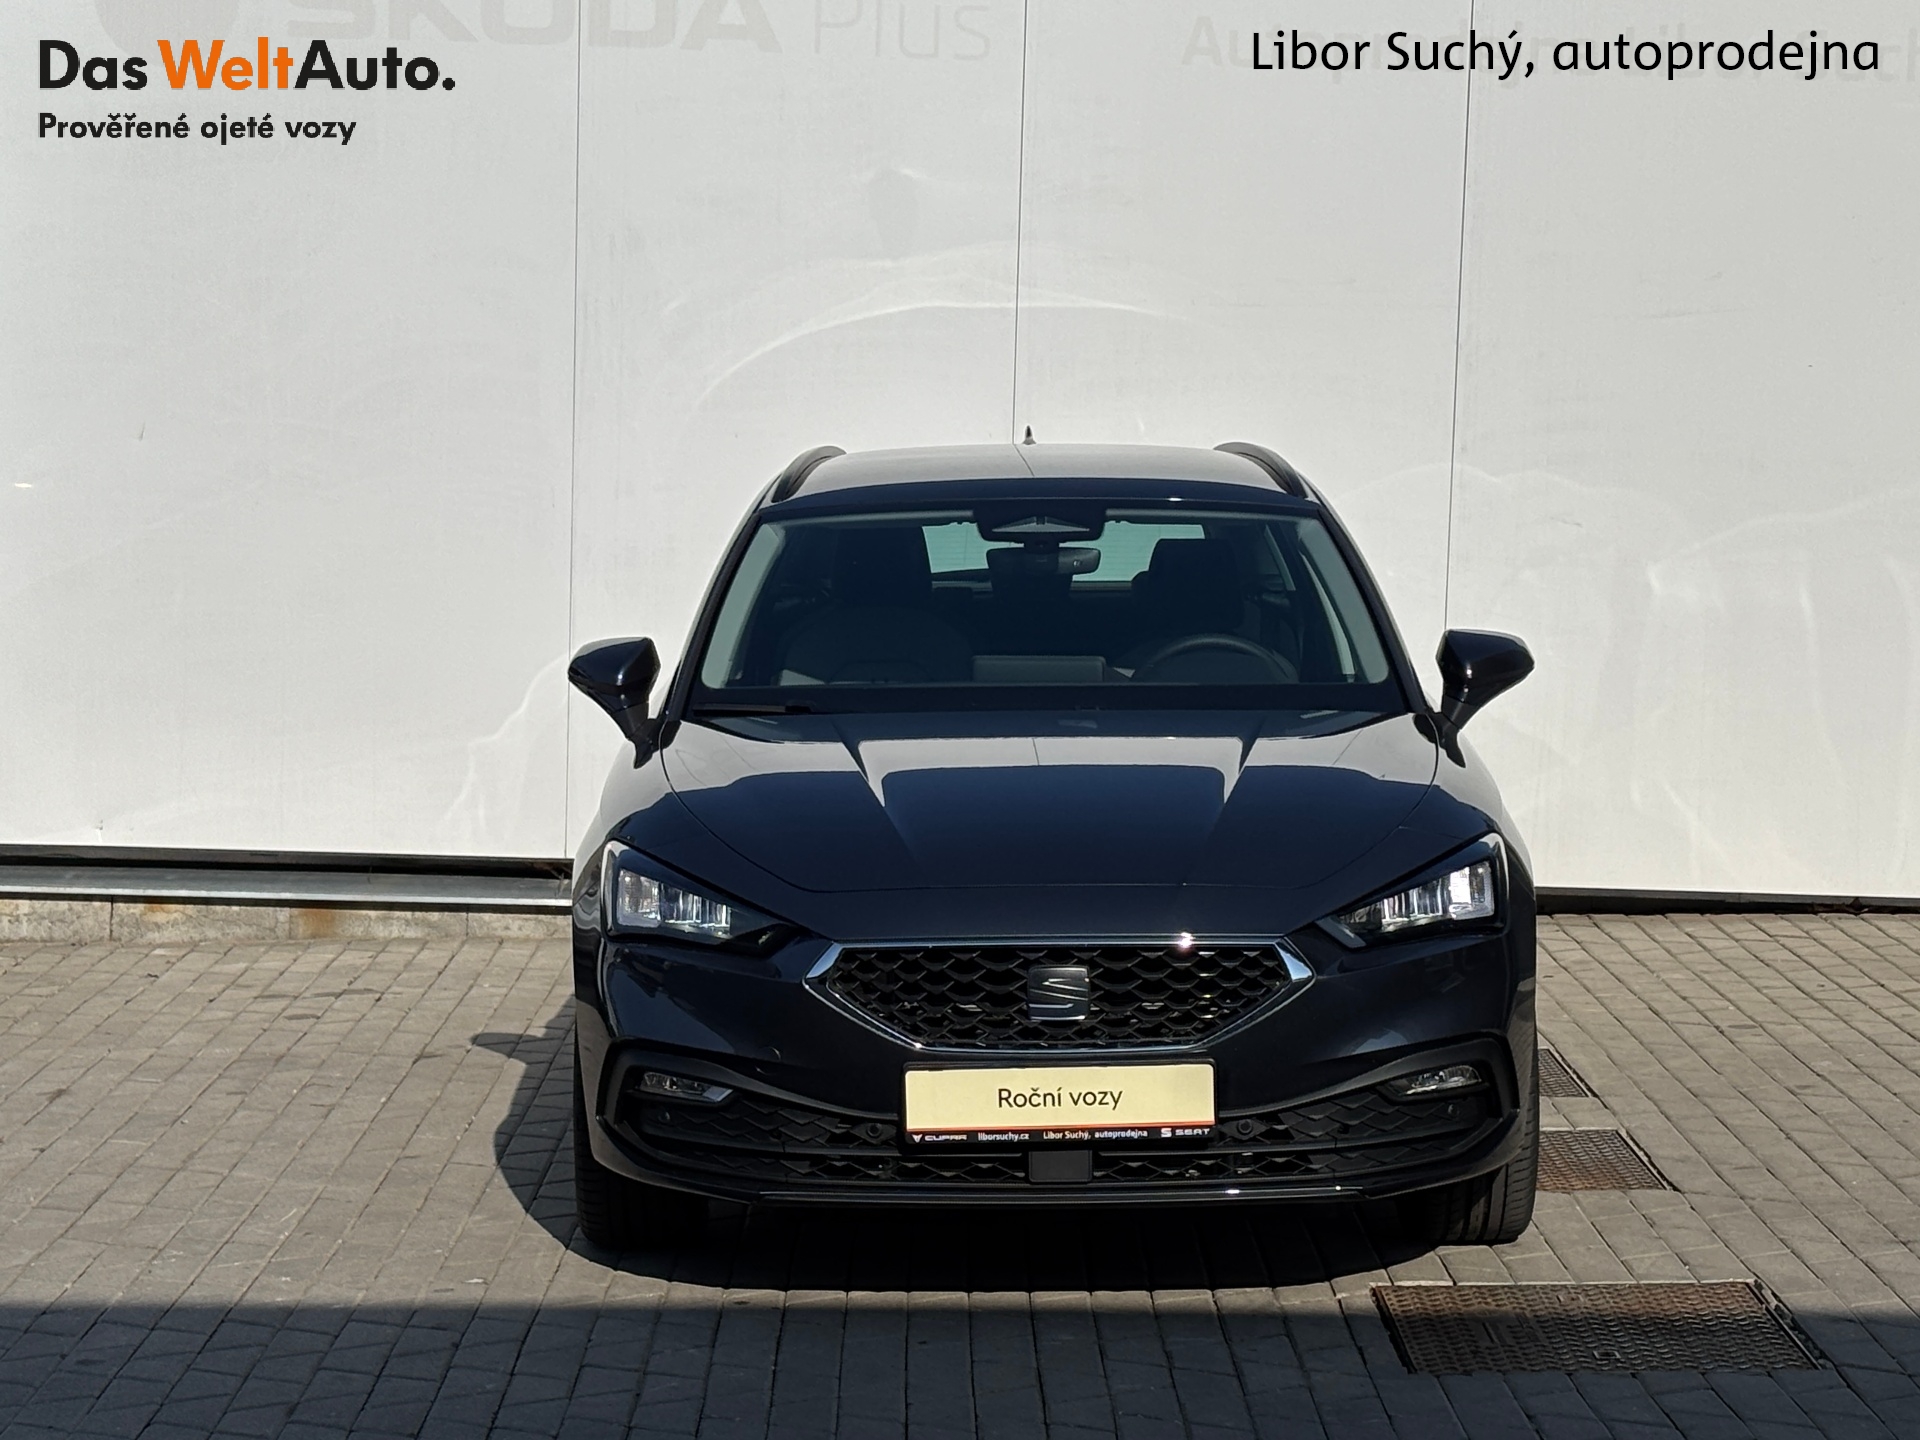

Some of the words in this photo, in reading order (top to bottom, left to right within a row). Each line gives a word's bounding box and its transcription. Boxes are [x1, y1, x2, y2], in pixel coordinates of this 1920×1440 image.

[997, 1087, 1062, 1108] Roční
[1069, 1090, 1123, 1111] vozy
[977, 1131, 1030, 1143] liborsuchy.cz
[1043, 1130, 1063, 1140] Libor
[1094, 1128, 1148, 1140] autoprodejna
[1175, 1128, 1211, 1137] SEAT
